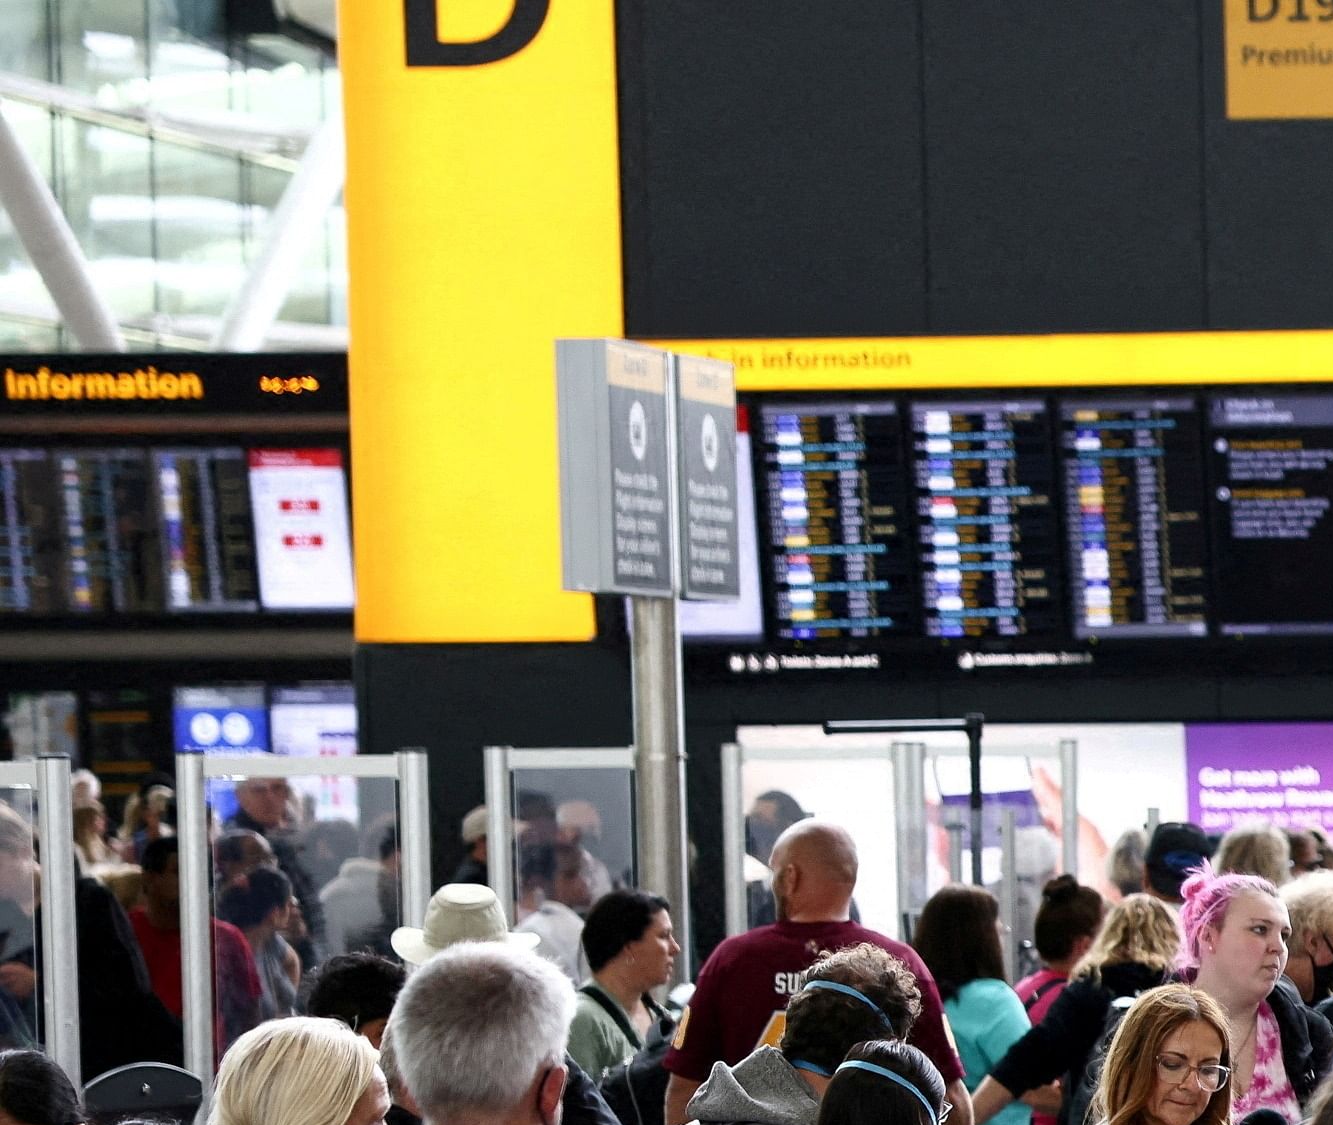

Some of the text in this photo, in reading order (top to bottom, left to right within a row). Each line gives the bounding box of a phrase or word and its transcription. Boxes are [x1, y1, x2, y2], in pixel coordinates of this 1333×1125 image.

[761, 345, 912, 369] information
[5, 367, 203, 400] Information
[1199, 766, 1320, 787] Get more with
[775, 972, 803, 994] SU
